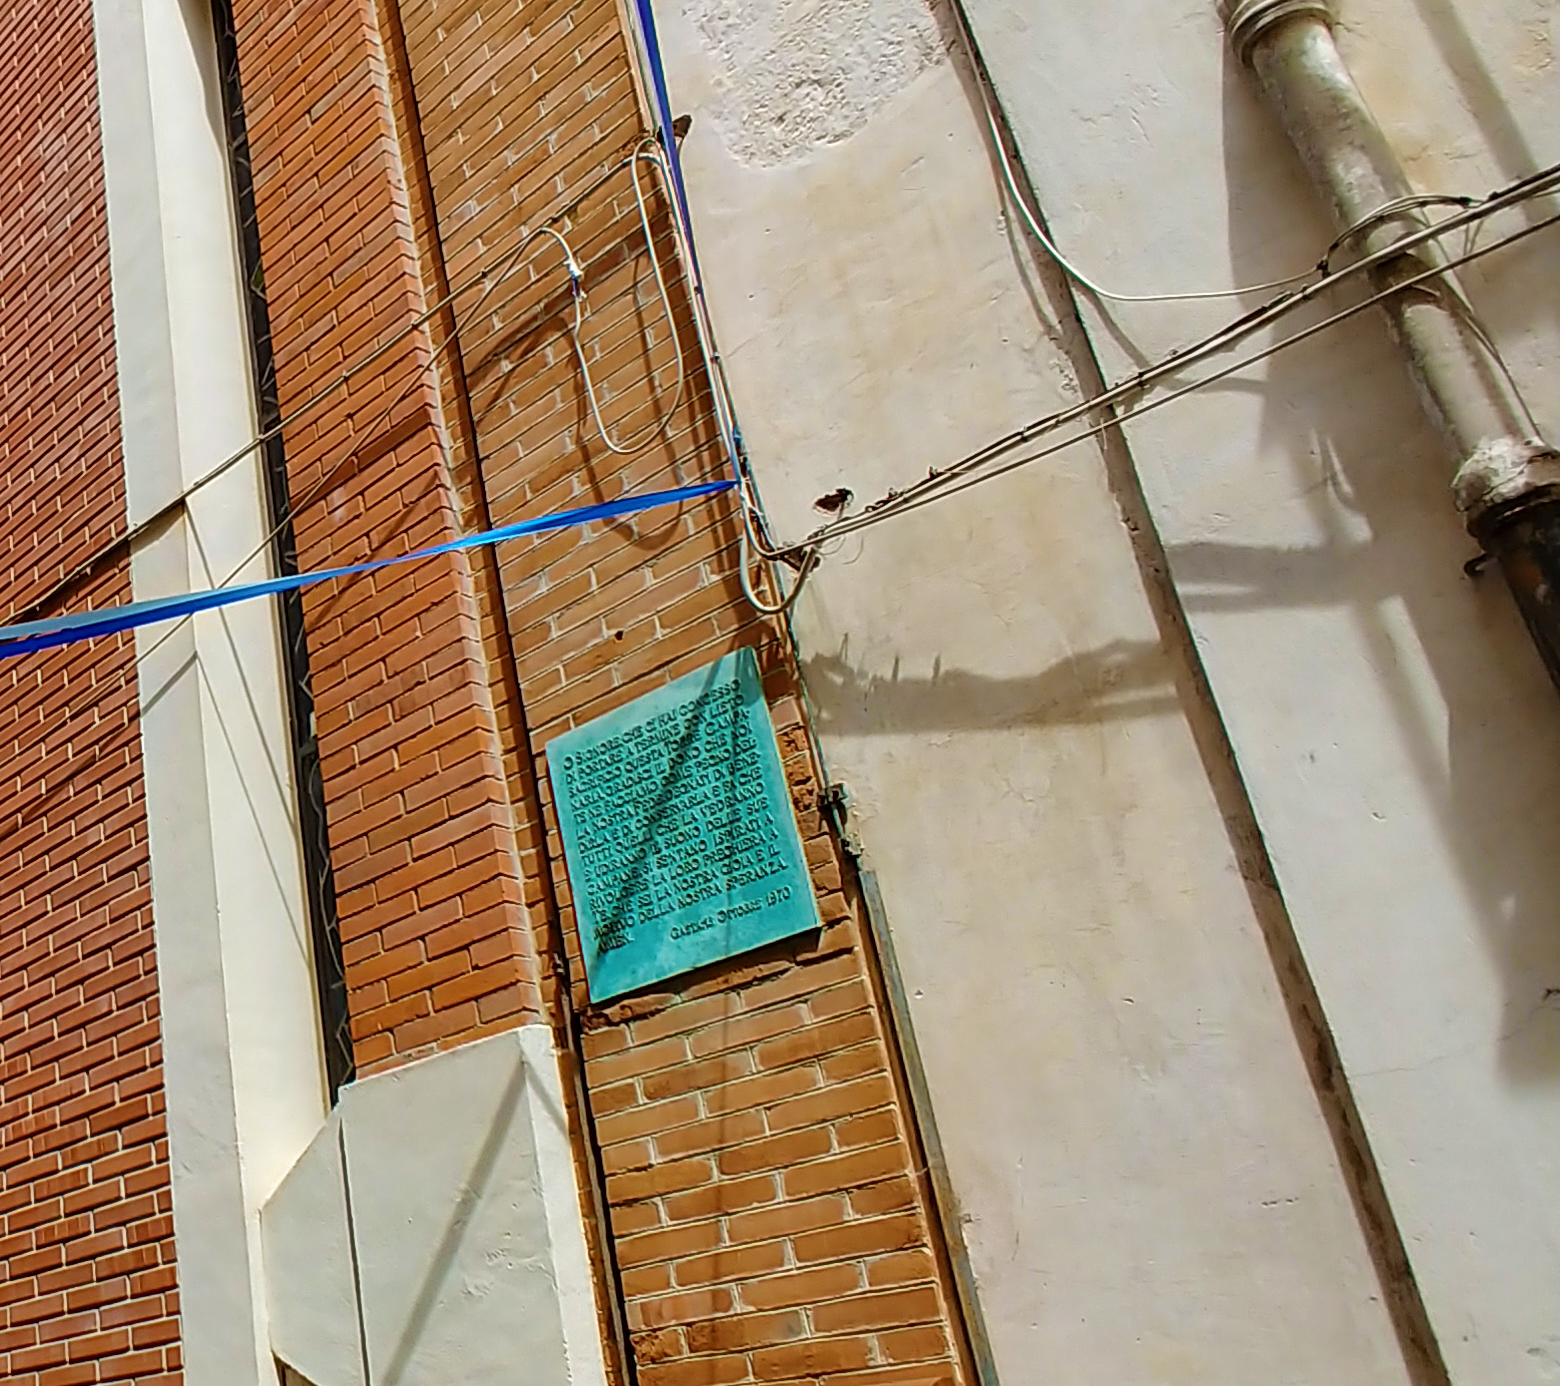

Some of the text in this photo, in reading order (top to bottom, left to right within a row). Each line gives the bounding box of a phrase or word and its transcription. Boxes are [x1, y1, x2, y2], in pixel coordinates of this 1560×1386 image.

[579, 749, 622, 777] PORTARE
[625, 744, 634, 756] A
[635, 723, 680, 752] TERMINE
[683, 711, 706, 730] CON
[710, 694, 744, 718] LIETO
[622, 724, 643, 742] CHE
[644, 718, 657, 732] CI
[658, 709, 676, 726] HAI
[679, 679, 740, 716] CONCESSO
[568, 765, 621, 797] SACRIFICIO
[624, 746, 663, 772] QUESTA
[664, 729, 700, 754] TORRE
[655, 761, 665, 774] IL
[668, 746, 700, 768] DONO
[703, 734, 726, 752] CHE
[731, 723, 751, 740] NOI
[575, 811, 586, 824] TE
[588, 805, 601, 818] NE
[604, 780, 657, 811] FACCIAMO
[660, 765, 692, 787] COME
[694, 748, 731, 772] PEGNO
[576, 824, 590, 839] LA
[592, 806, 633, 832] NOSTRA
[665, 773, 710, 801] DEGNATI
[713, 766, 725, 780] DI
[579, 832, 609, 853] DIRLA
[612, 828, 619, 839] E
[621, 822, 632, 835] DI
[635, 789, 710, 829] CONSERVARLA
[712, 785, 720, 796] E
[738, 768, 762, 785] CHE
[581, 782, 764, 866] TUTTI QUELLI CHE LA VEDRANNO
[584, 870, 590, 881] E
[651, 841, 661, 854] IL
[663, 825, 701, 849] SUONO
[706, 808, 742, 831] DELLE
[746, 797, 769, 815] SUE
[655, 839, 707, 868] SENTANO
[713, 817, 760, 844] ISPIRATI
[763, 812, 773, 825] A
[589, 827, 778, 909] RIVOLGERE LA LORO PREGHIERA A
[610, 899, 633, 916] CHE
[636, 892, 652, 907] SEI
[655, 884, 671, 899] LA
[673, 866, 718, 892] NOSTRA
[720, 853, 753, 874] GIOIA
[755, 848, 764, 861] E
[768, 843, 779, 856] IL
[638, 900, 674, 922] DELLA
[676, 882, 721, 907] NOSTRA
[765, 886, 791, 905] 1970
